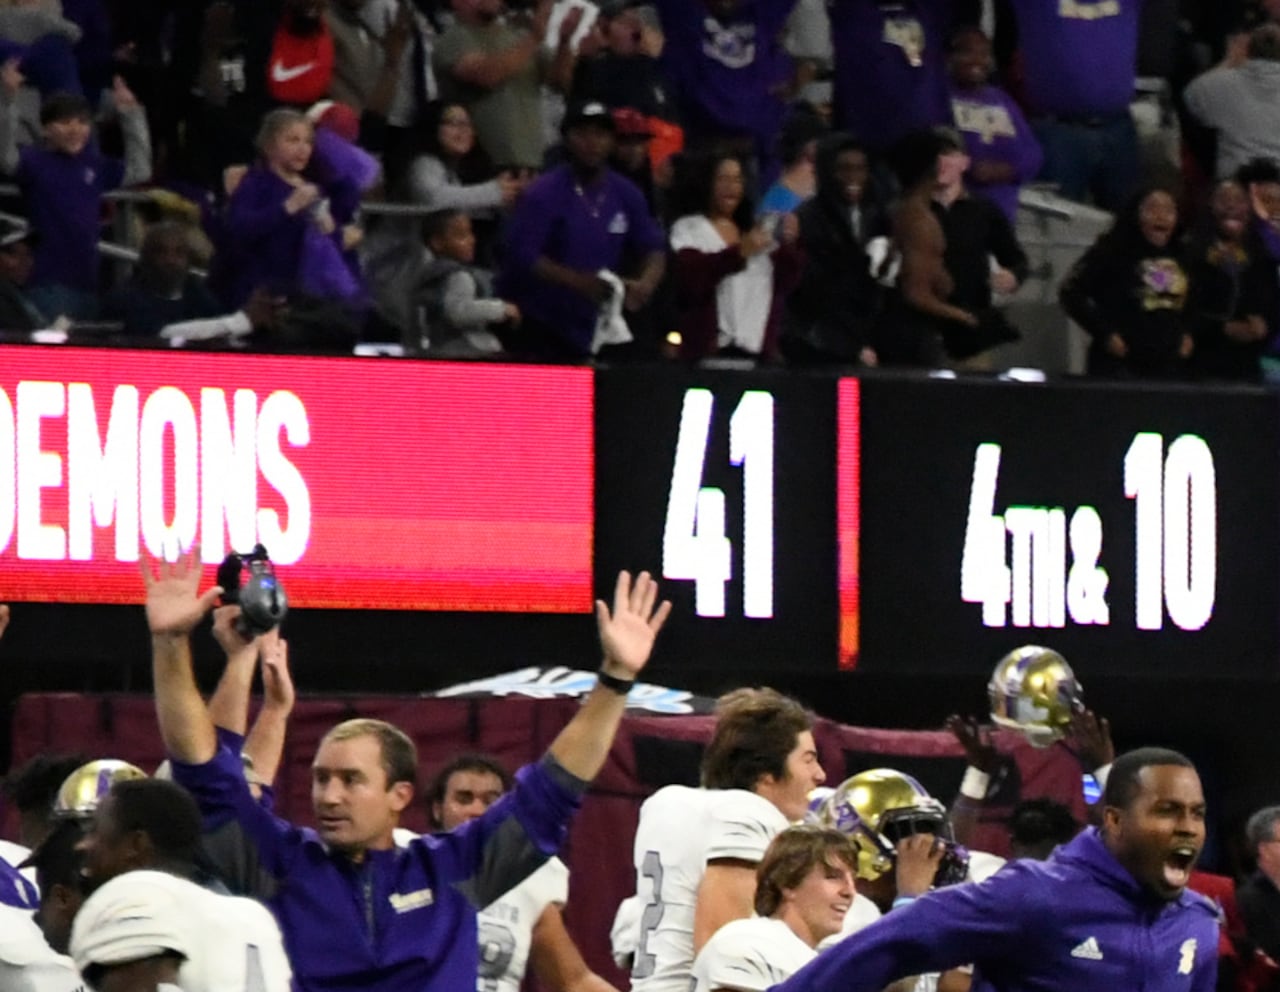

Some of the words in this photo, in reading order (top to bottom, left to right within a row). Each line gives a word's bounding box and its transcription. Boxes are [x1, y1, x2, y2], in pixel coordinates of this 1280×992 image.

[0, 380, 312, 564] EMONS
[662, 388, 774, 618] 41
[1124, 432, 1217, 631] 10
